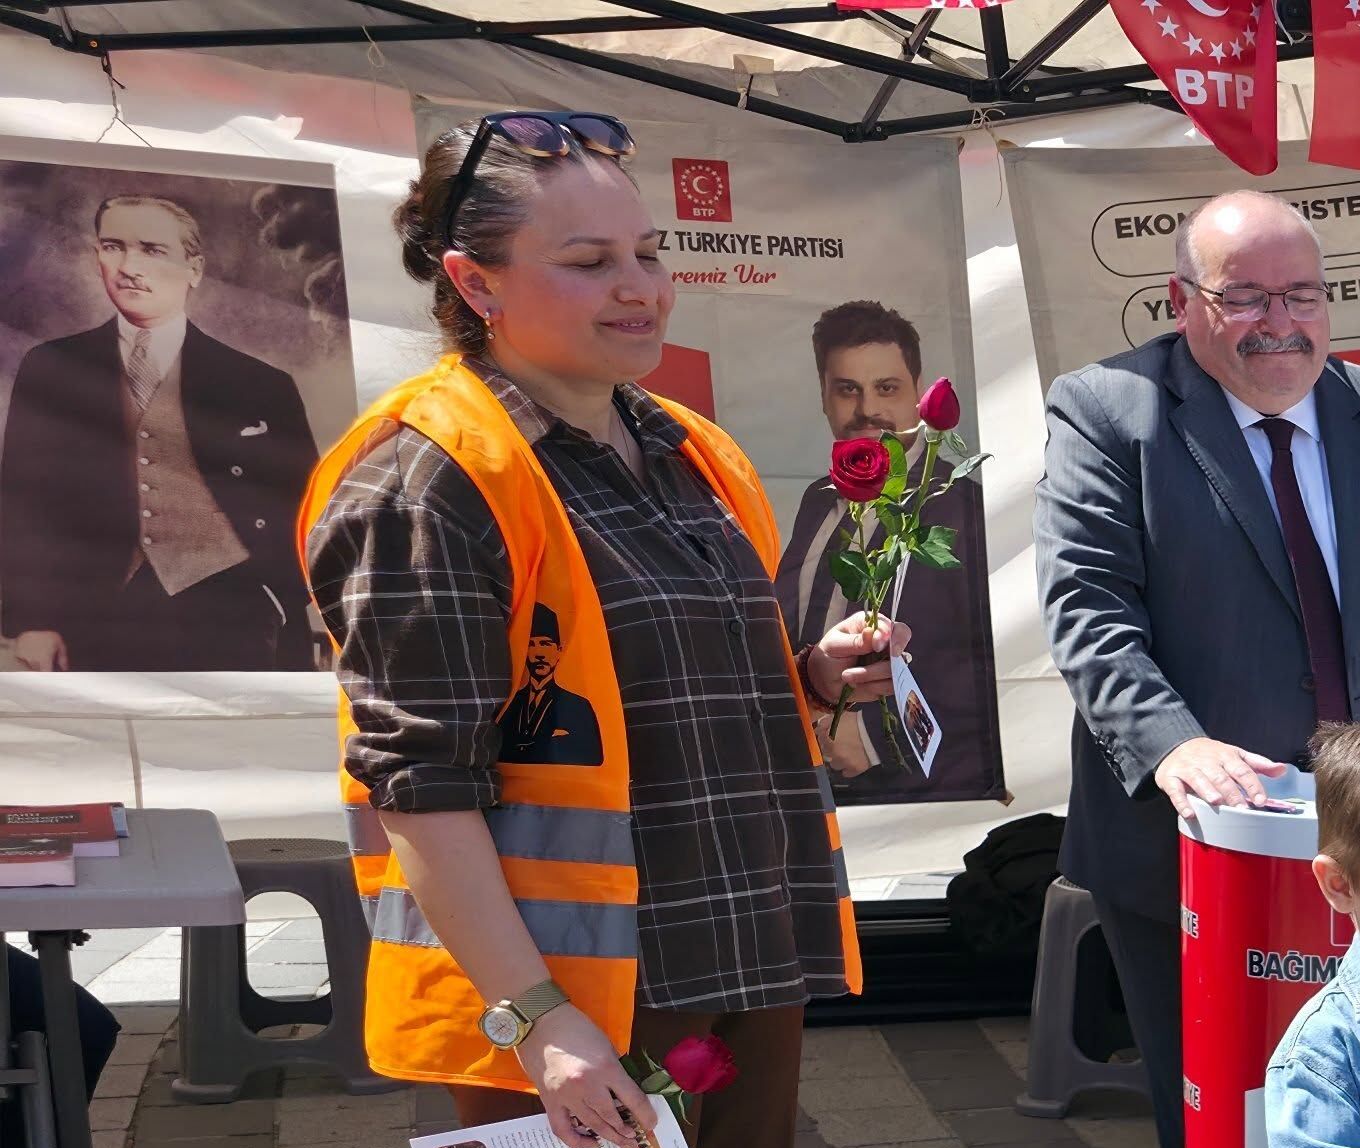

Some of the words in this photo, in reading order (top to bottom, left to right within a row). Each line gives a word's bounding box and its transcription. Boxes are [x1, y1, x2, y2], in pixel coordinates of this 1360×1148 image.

[1175, 69, 1255, 109] BTP
[692, 208, 716, 216] BTP
[675, 231, 763, 255] TÜRKİYE
[767, 235, 844, 259] PARTİSİ
[671, 267, 727, 284] remiz
[733, 264, 777, 284] Var
